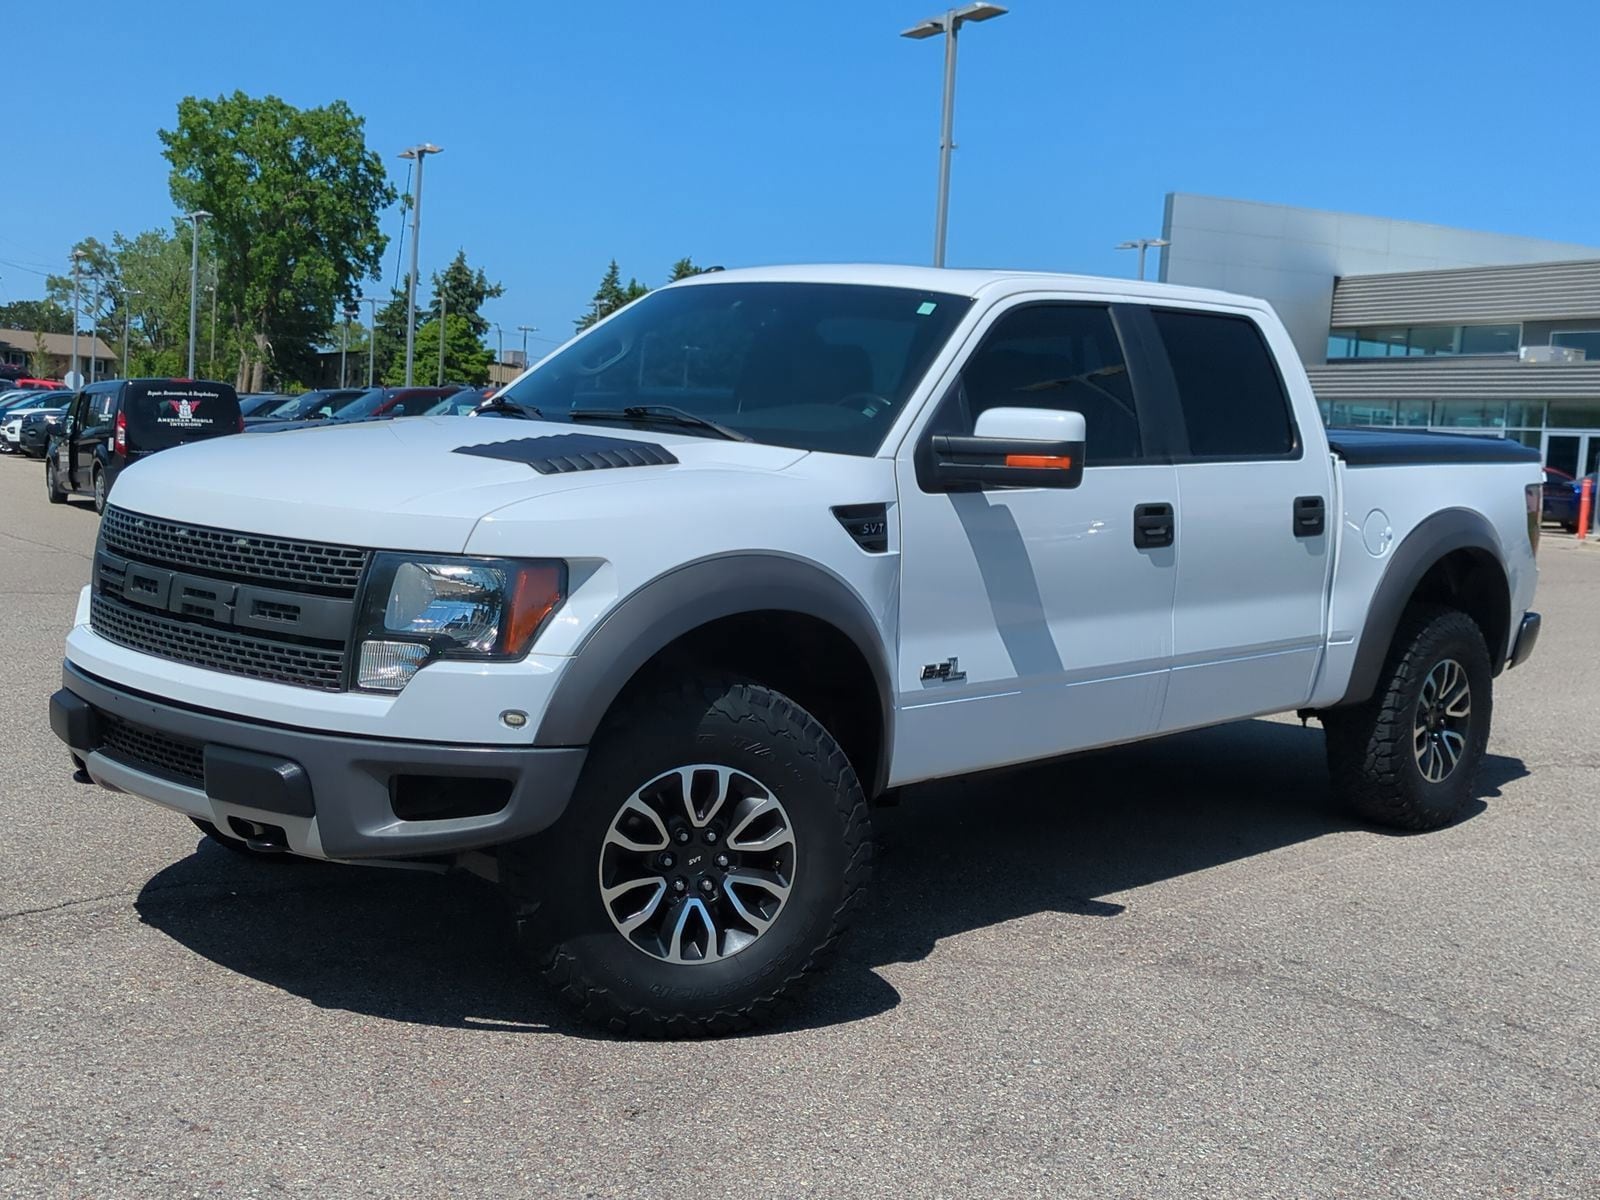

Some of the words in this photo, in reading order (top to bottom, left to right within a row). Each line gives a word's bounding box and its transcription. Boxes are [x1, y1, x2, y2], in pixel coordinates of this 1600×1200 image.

[863, 522, 884, 534] SVT
[95, 548, 322, 638] FORD
[688, 855, 702, 866] SVT
